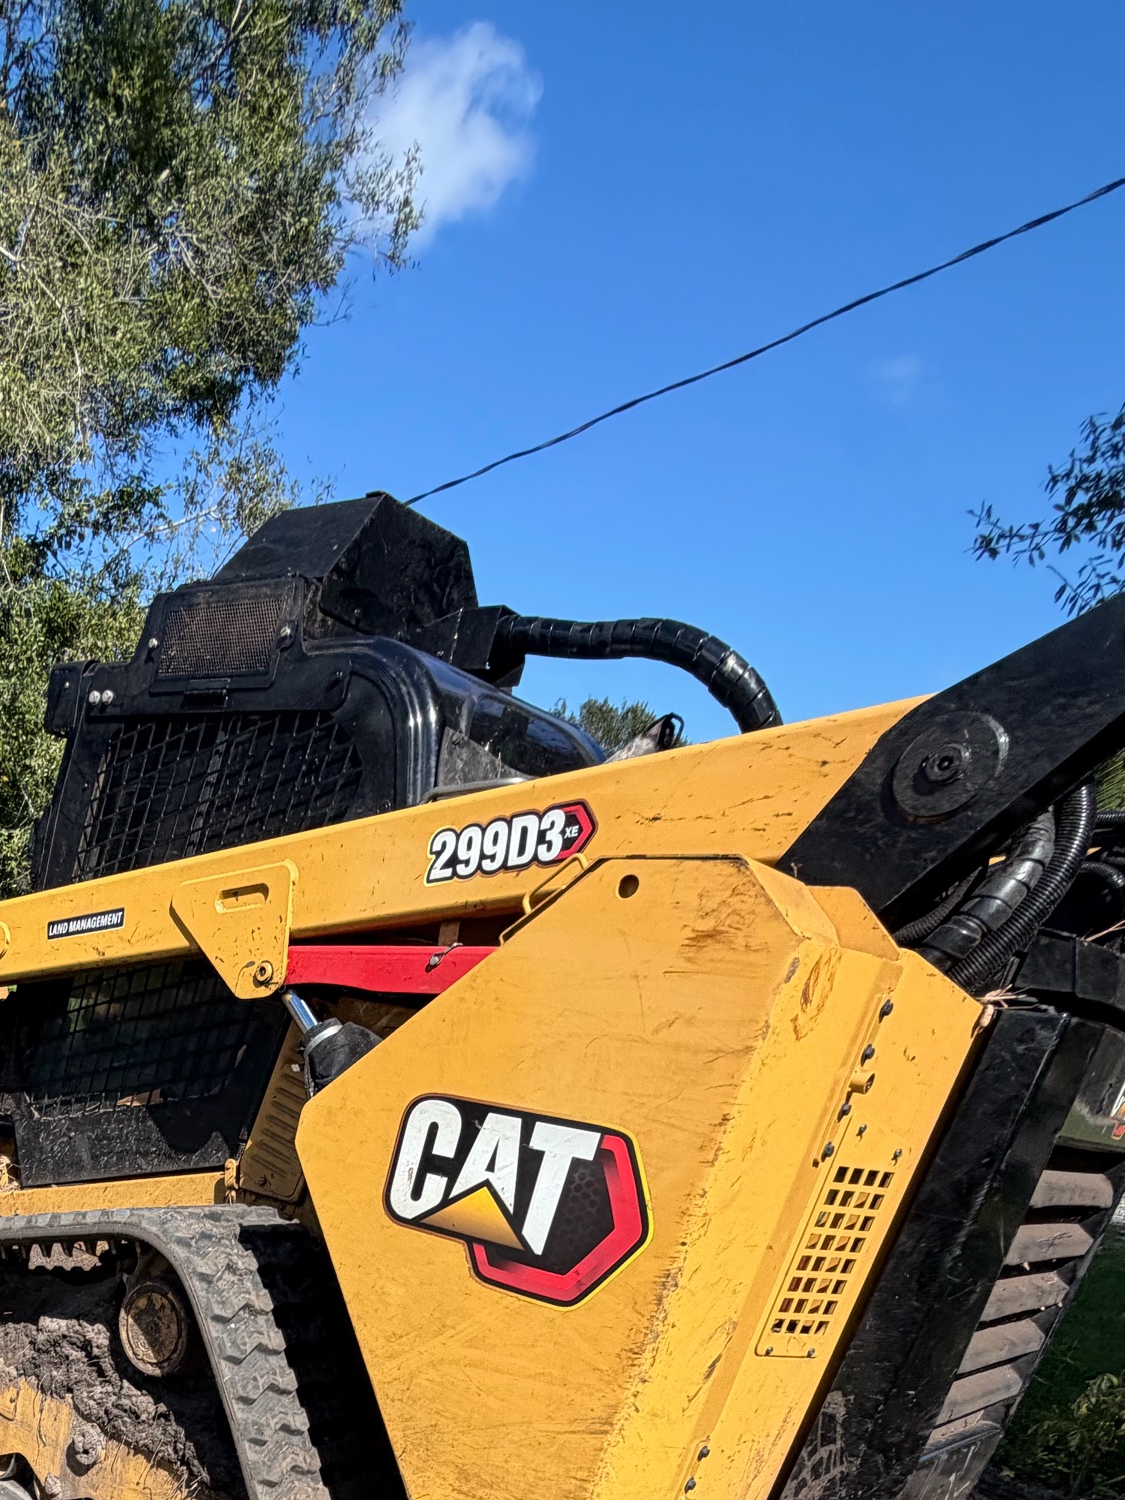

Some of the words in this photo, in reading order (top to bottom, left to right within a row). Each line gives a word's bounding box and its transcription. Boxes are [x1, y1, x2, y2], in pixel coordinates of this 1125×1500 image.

[429, 808, 566, 881] 299D3
[564, 825, 579, 839] XE
[48, 922, 67, 936] LAND
[68, 911, 123, 933] MANAGEMENT
[390, 1099, 601, 1256] CAT
